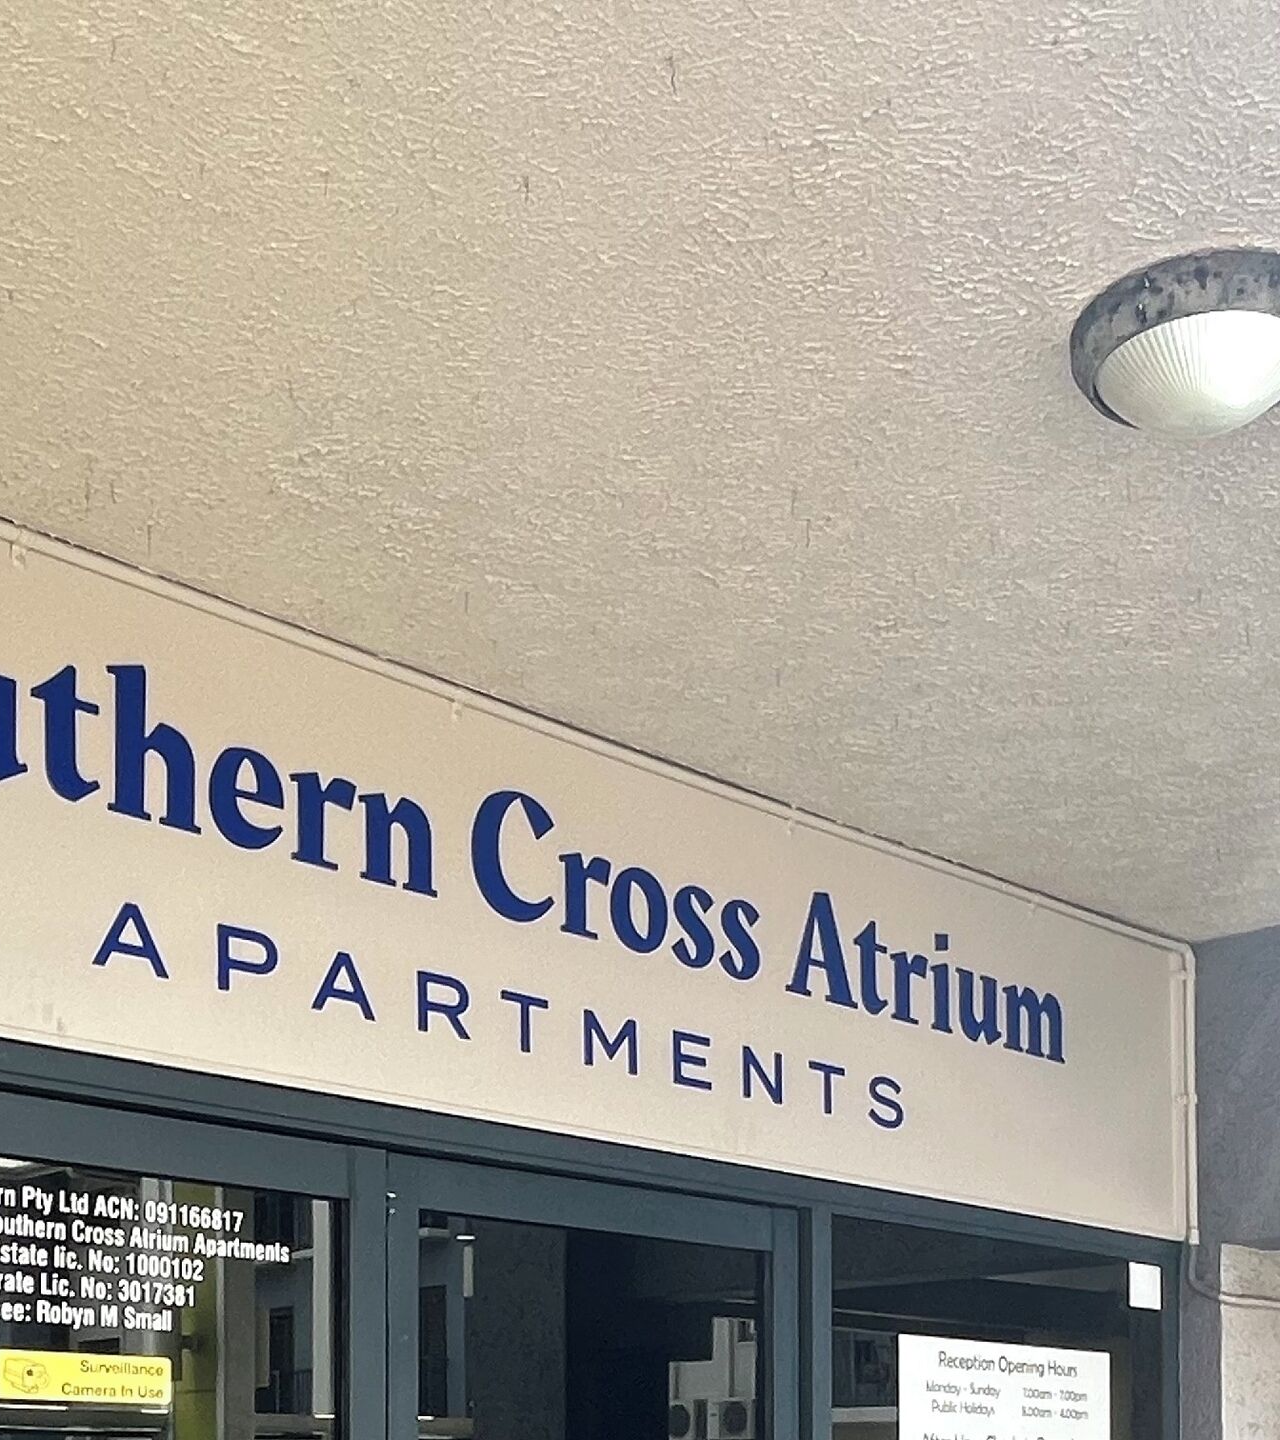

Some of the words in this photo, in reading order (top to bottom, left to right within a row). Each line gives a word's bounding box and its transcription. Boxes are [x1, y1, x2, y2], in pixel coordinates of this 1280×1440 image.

[471, 789, 761, 980] Cross
[786, 892, 1066, 1064] Atrium
[93, 901, 906, 1130] APARTMENTS
[21, 1185, 54, 1216] Pty
[59, 1190, 89, 1215] Ltd
[93, 1195, 140, 1222] ACN:
[144, 1200, 244, 1233] 091166817
[72, 1219, 126, 1247] Cross
[129, 1226, 189, 1254] Atrium
[193, 1232, 290, 1264] Apartments
[53, 1245, 84, 1271] lic.
[88, 1248, 120, 1275] No:
[125, 1252, 204, 1282] 1000102
[40, 1272, 76, 1298] Lic.
[80, 1276, 113, 1301] No:
[118, 1278, 195, 1307] 3017381
[36, 1299, 95, 1330] Robyn
[100, 1304, 118, 1328] M
[123, 1305, 173, 1332] Small
[80, 1359, 164, 1377] Surveillance
[939, 1351, 996, 1371] Reception
[999, 1356, 1045, 1378] Opening
[1049, 1360, 1078, 1377] Hours
[61, 1381, 117, 1397] Camera
[121, 1384, 133, 1398] In
[137, 1385, 164, 1399] Use
[926, 1380, 961, 1397] Monday
[970, 1382, 1001, 1400] Sunday
[932, 1398, 958, 1413] Public
[960, 1401, 996, 1418] Holidays
